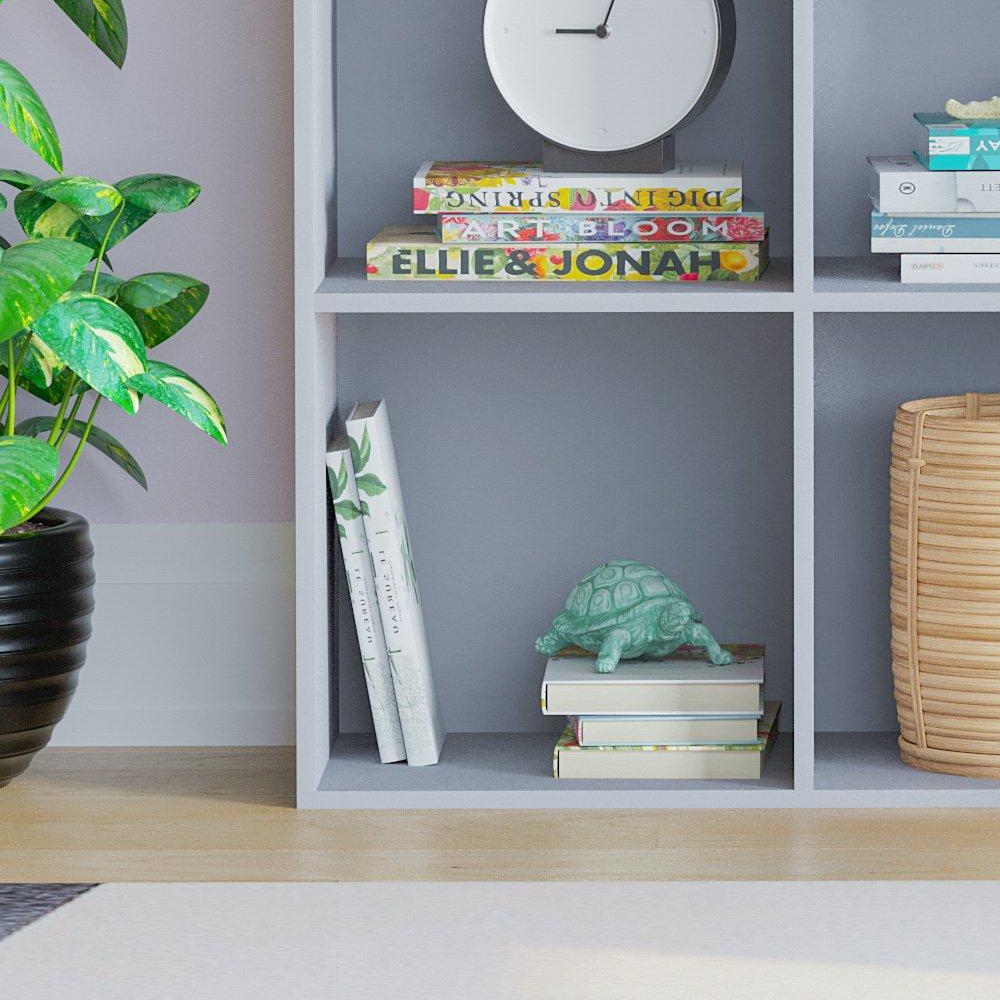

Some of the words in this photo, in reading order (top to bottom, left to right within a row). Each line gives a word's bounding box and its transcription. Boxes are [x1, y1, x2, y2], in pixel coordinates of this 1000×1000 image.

[445, 189, 560, 208] SPRING
[575, 189, 658, 208] INTO
[667, 189, 723, 208] DIG
[463, 219, 551, 238] ART
[577, 219, 730, 238] BLOOM
[873, 218, 909, 237] Defoe
[912, 222, 956, 237] Daniel
[392, 249, 496, 276] ELLIE
[504, 249, 540, 276] &
[551, 249, 721, 277] JONAH
